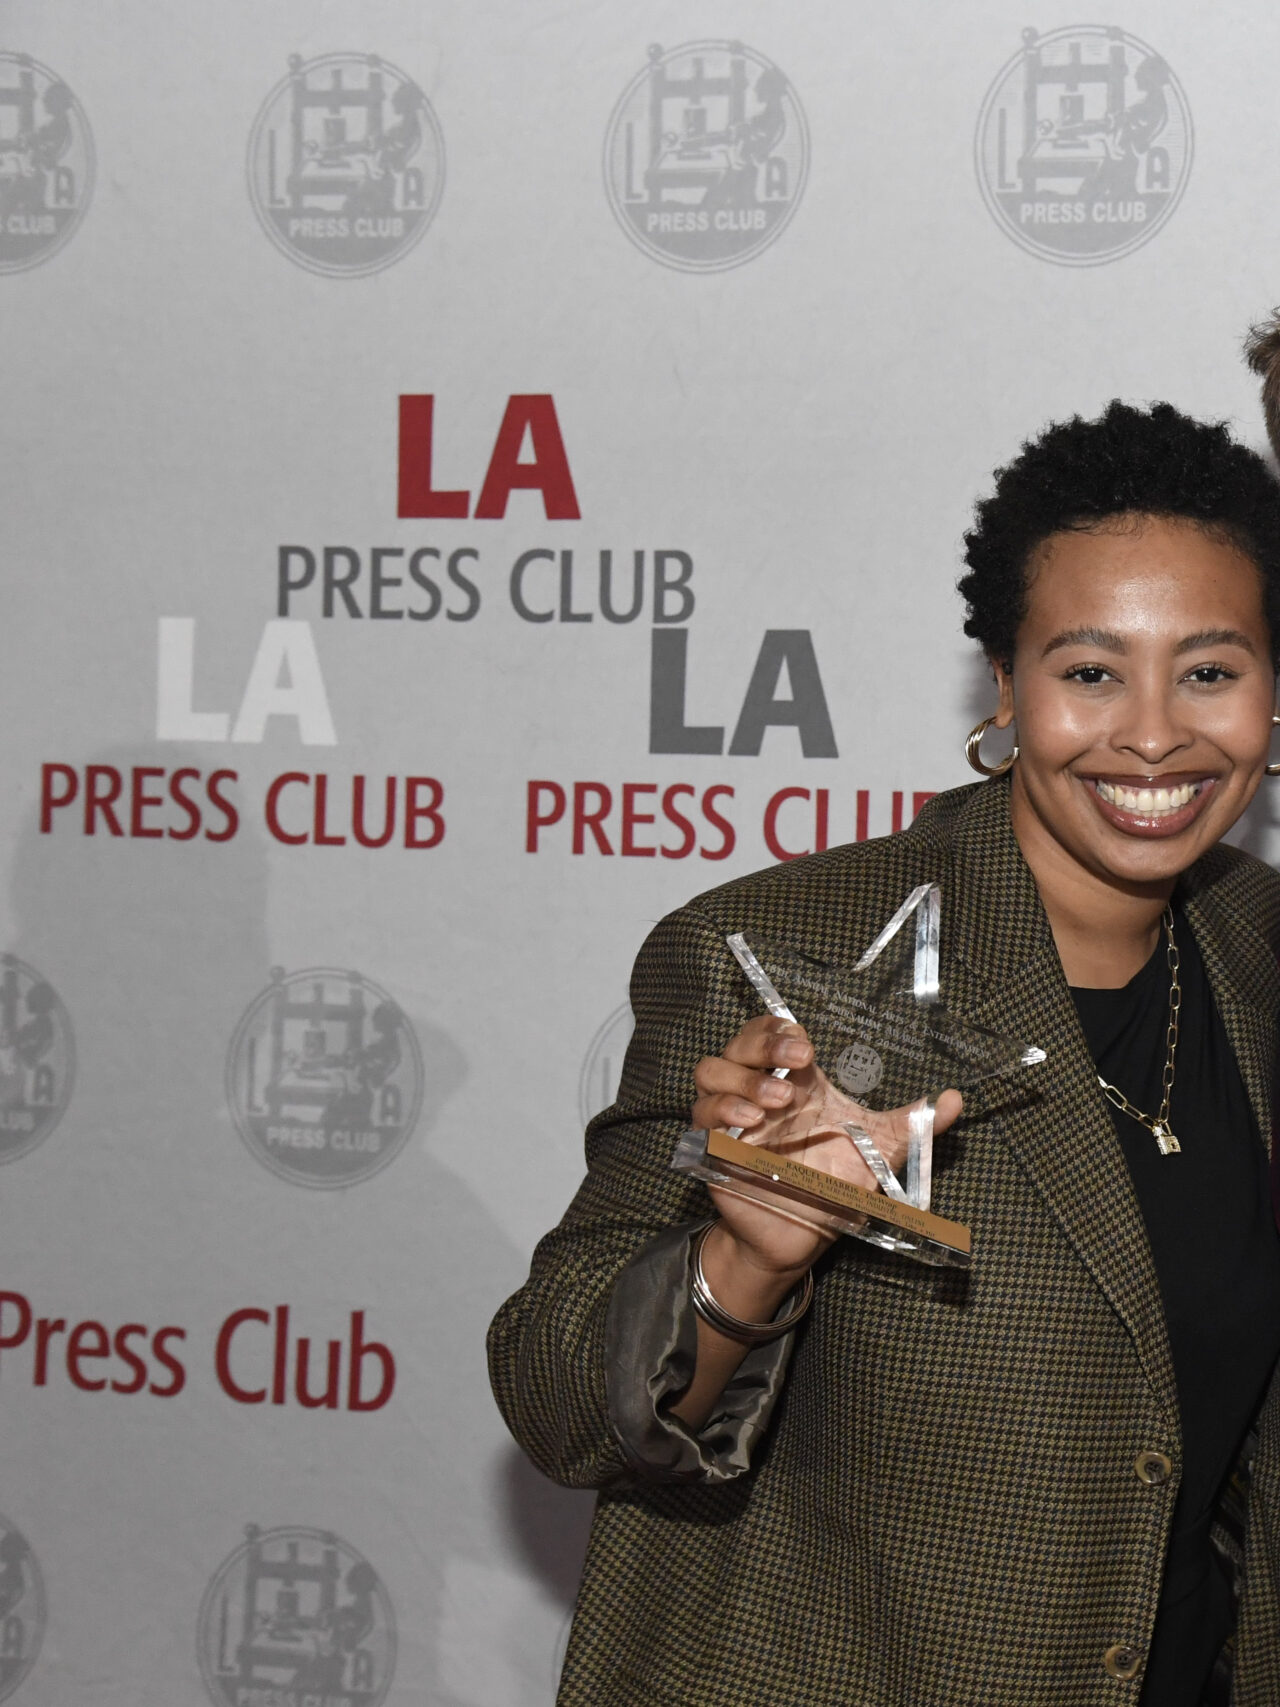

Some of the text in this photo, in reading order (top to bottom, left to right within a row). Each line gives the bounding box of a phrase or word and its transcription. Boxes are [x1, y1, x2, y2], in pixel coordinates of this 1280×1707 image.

[289, 218, 403, 238] PRESS CLUB
[647, 209, 766, 232] PRESS CLUB
[1020, 201, 1147, 224] PRESS CLUB
[397, 394, 581, 520] LA
[278, 546, 694, 624] PRESS CLUB
[157, 618, 338, 746] LA
[649, 628, 839, 758] LA
[40, 763, 446, 849] PRESS CLUB
[525, 781, 736, 860] PRESS
[267, 1127, 380, 1152] PRESS CLUB
[785, 1161, 820, 1179] RAQUEL
[824, 1176, 859, 1194] HARRIS
[0, 1291, 396, 1412] Press Club
